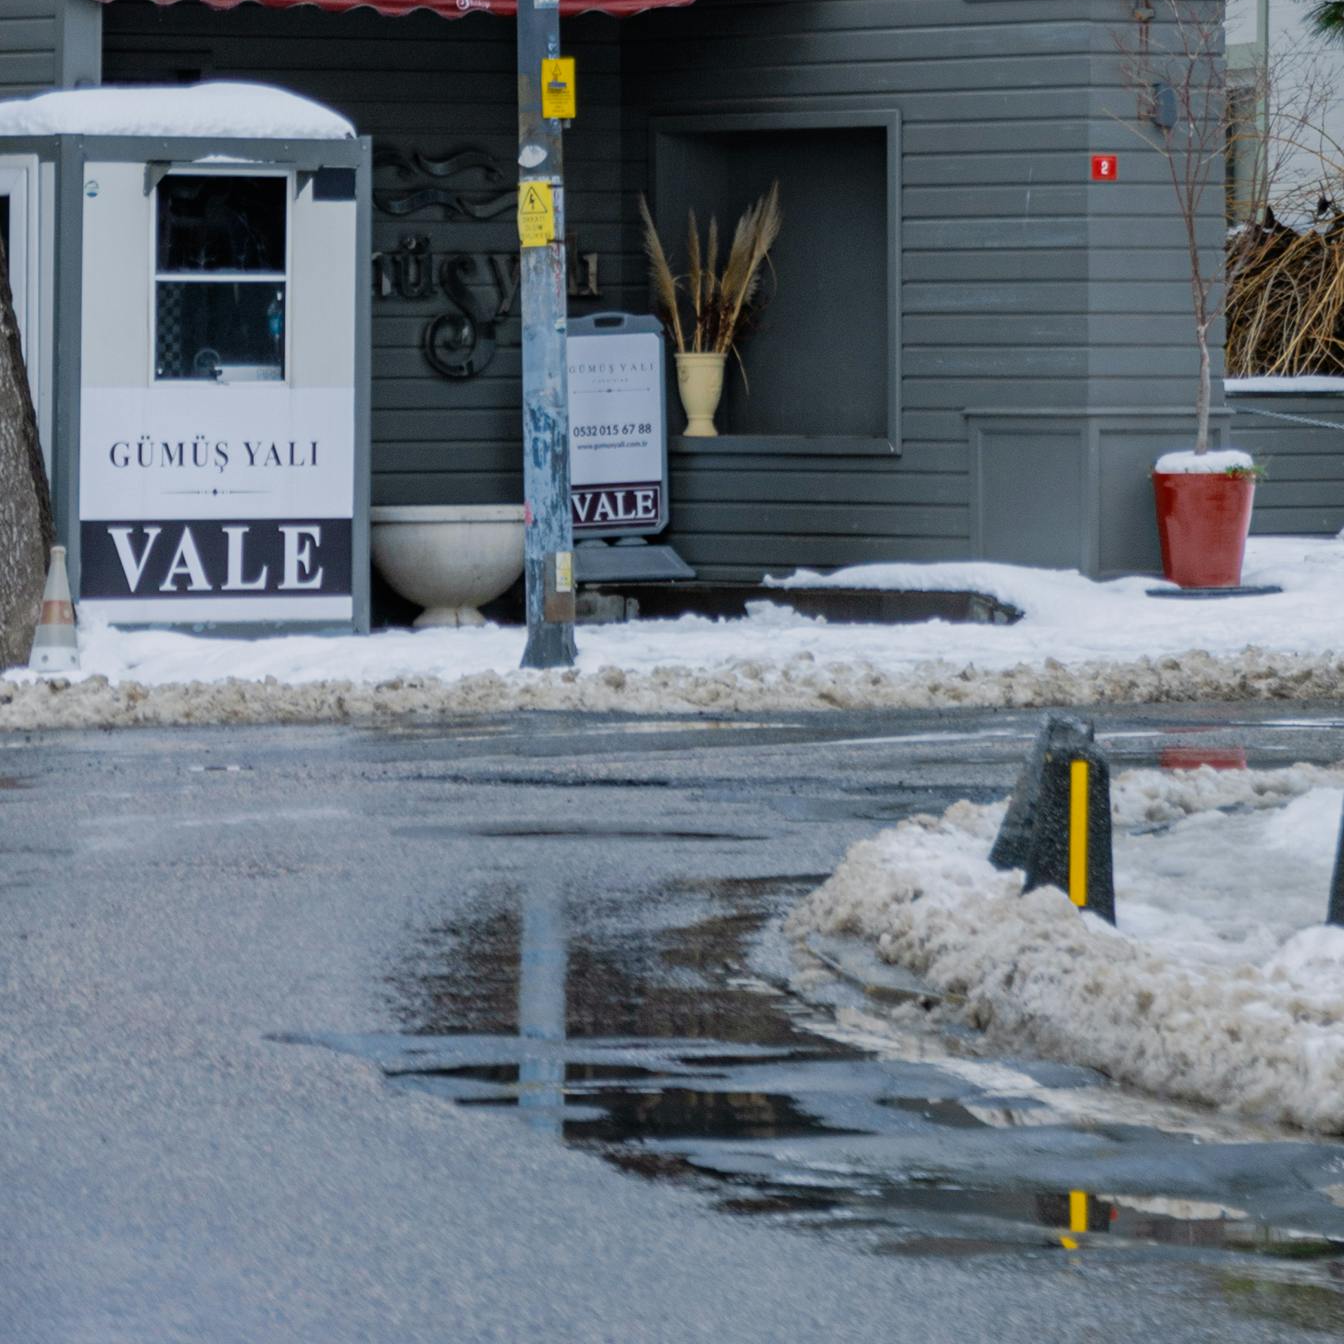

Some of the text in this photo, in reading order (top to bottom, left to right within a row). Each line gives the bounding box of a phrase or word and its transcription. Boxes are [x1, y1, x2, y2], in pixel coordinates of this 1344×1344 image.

[1100, 160, 1109, 175] 2
[573, 423, 652, 437] 0532 015 67 88
[109, 435, 318, 472] GÜMÜŞ YALI
[571, 491, 656, 522] VALE
[107, 525, 323, 593] VALE
